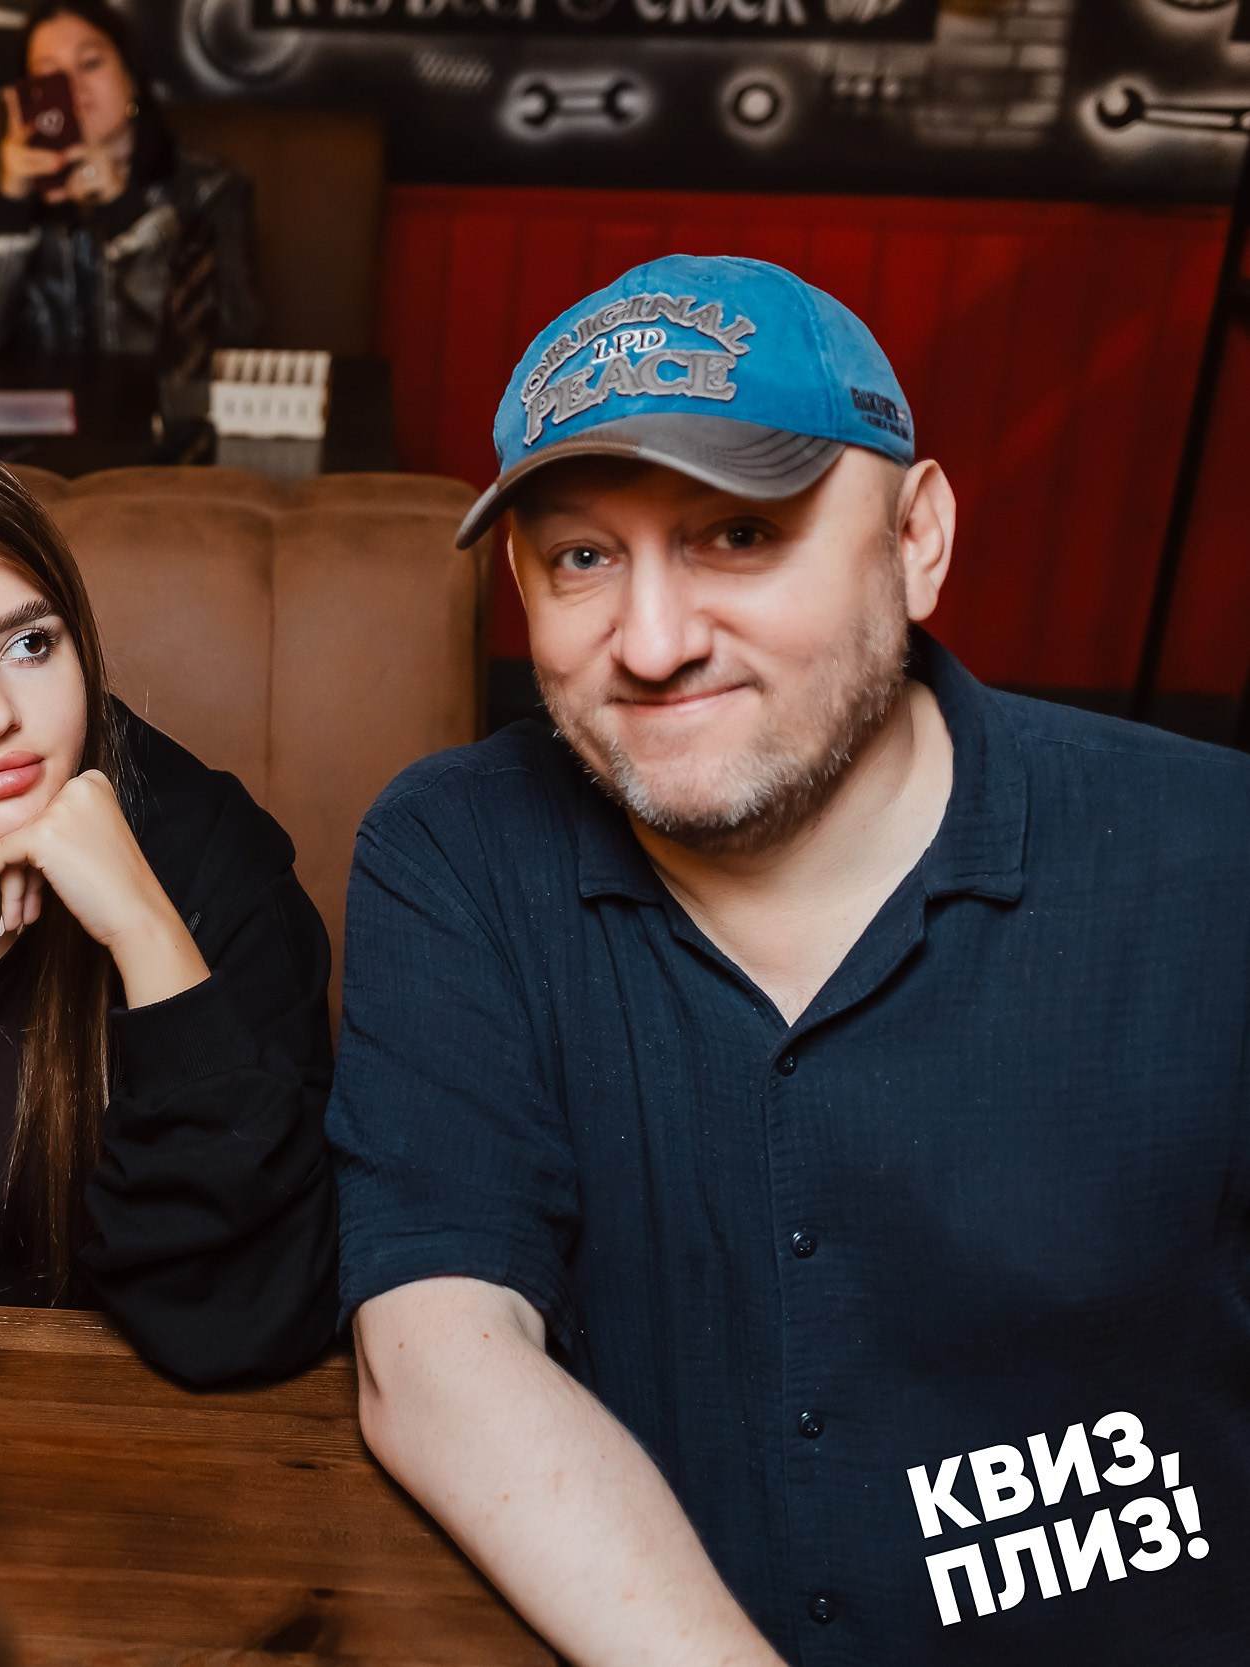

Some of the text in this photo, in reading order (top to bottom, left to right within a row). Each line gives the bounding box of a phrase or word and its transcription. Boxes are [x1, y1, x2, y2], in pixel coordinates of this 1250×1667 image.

[521, 291, 756, 405] ORIGINAL
[591, 327, 667, 364] LPD
[523, 350, 737, 446] PEACE
